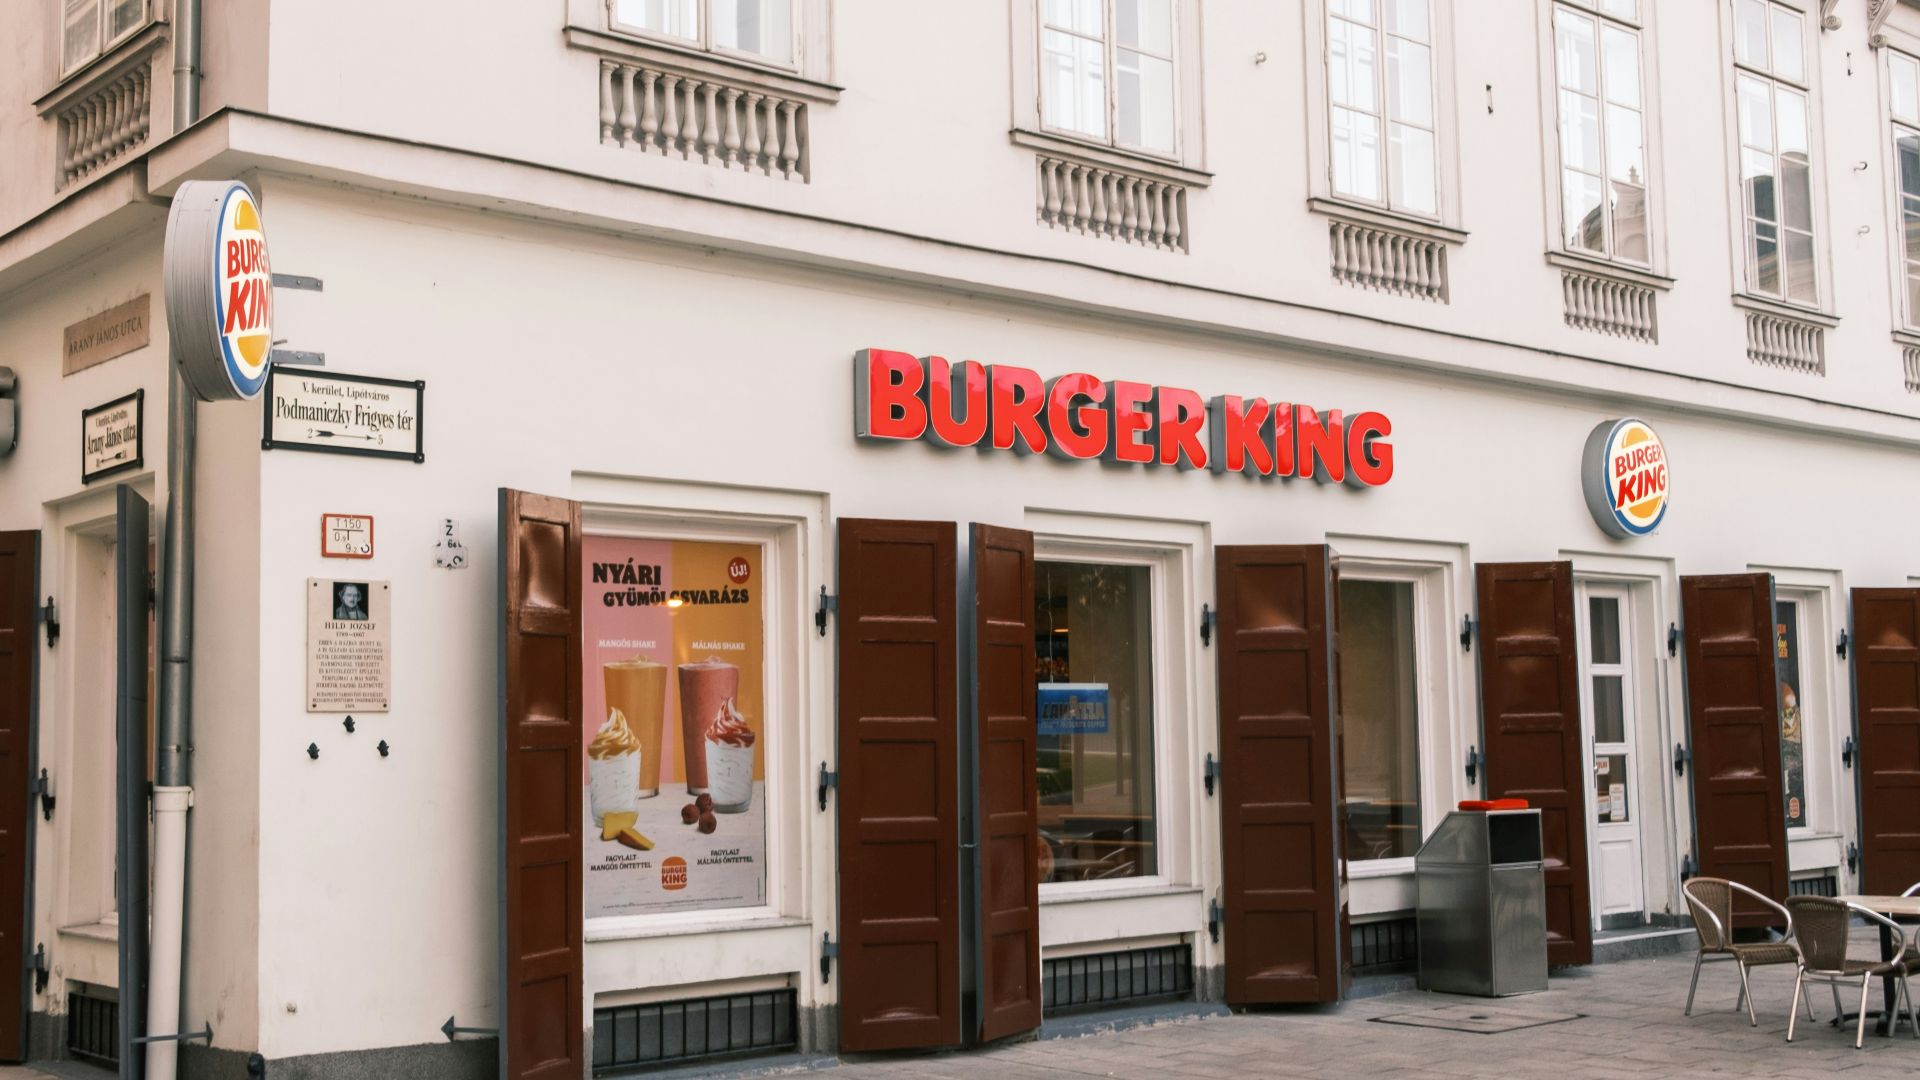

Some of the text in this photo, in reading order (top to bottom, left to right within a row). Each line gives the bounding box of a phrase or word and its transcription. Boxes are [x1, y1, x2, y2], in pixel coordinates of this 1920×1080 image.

[227, 239, 267, 279] BURG
[224, 278, 271, 334] KIN
[69, 335, 95, 354] ARANY
[121, 316, 142, 336] UTCA
[302, 382, 390, 401] V. kerület, Lipótváros
[275, 396, 414, 431] Podmaniczky Frigyes tér
[860, 347, 1394, 487] BURGER KING
[87, 434, 104, 455] Arany
[105, 426, 122, 448] János
[123, 421, 137, 442] utca
[307, 427, 313, 439] 2
[378, 434, 384, 445] 5
[1615, 444, 1663, 478] BURGER
[1616, 463, 1666, 509] KING
[445, 524, 453, 536] Z
[592, 557, 662, 586] NYÁRI
[730, 562, 748, 578] ÚJ!
[632, 640, 657, 649] SHAKE
[692, 640, 746, 650] MÁLNÁS SHAKE
[606, 854, 637, 862] FAGYLALT
[711, 848, 740, 857] FAGYLALT
[661, 866, 688, 875] BURGER
[661, 873, 688, 884] KING
